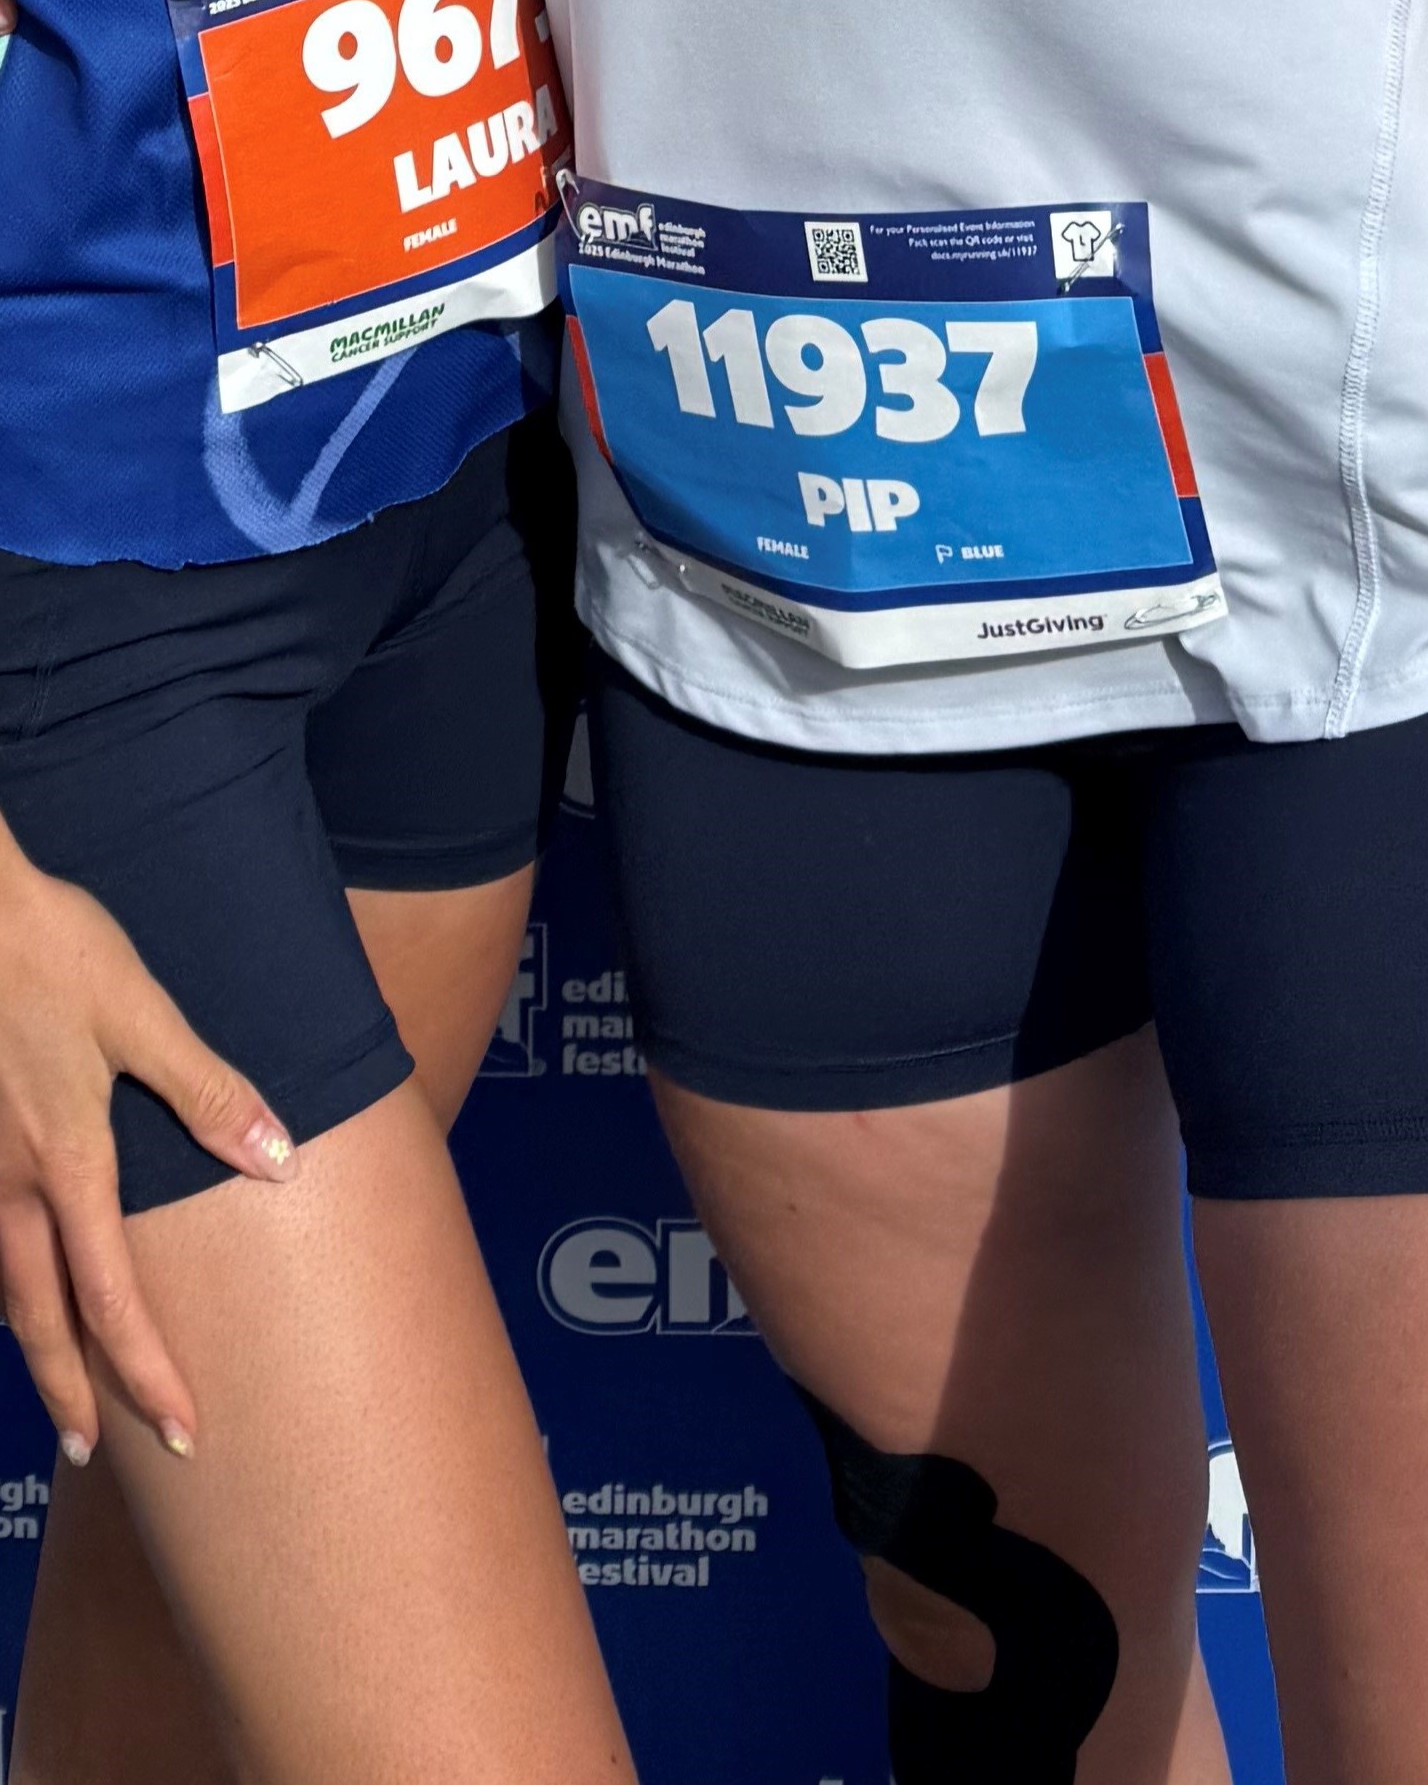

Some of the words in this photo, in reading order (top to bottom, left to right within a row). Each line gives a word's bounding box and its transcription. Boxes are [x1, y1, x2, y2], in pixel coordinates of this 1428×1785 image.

[393, 84, 558, 213] LAURA
[402, 218, 458, 253] FEMALE
[965, 235, 981, 248] QR
[329, 302, 445, 354] MACMILLAN
[331, 339, 381, 363] CANCER
[384, 318, 439, 347] SUPPORT
[646, 298, 1039, 443] 11937
[798, 472, 921, 533] PIP
[756, 536, 810, 560] FEMALE
[961, 544, 1005, 561] BLUE
[976, 613, 1105, 641] JustGiving
